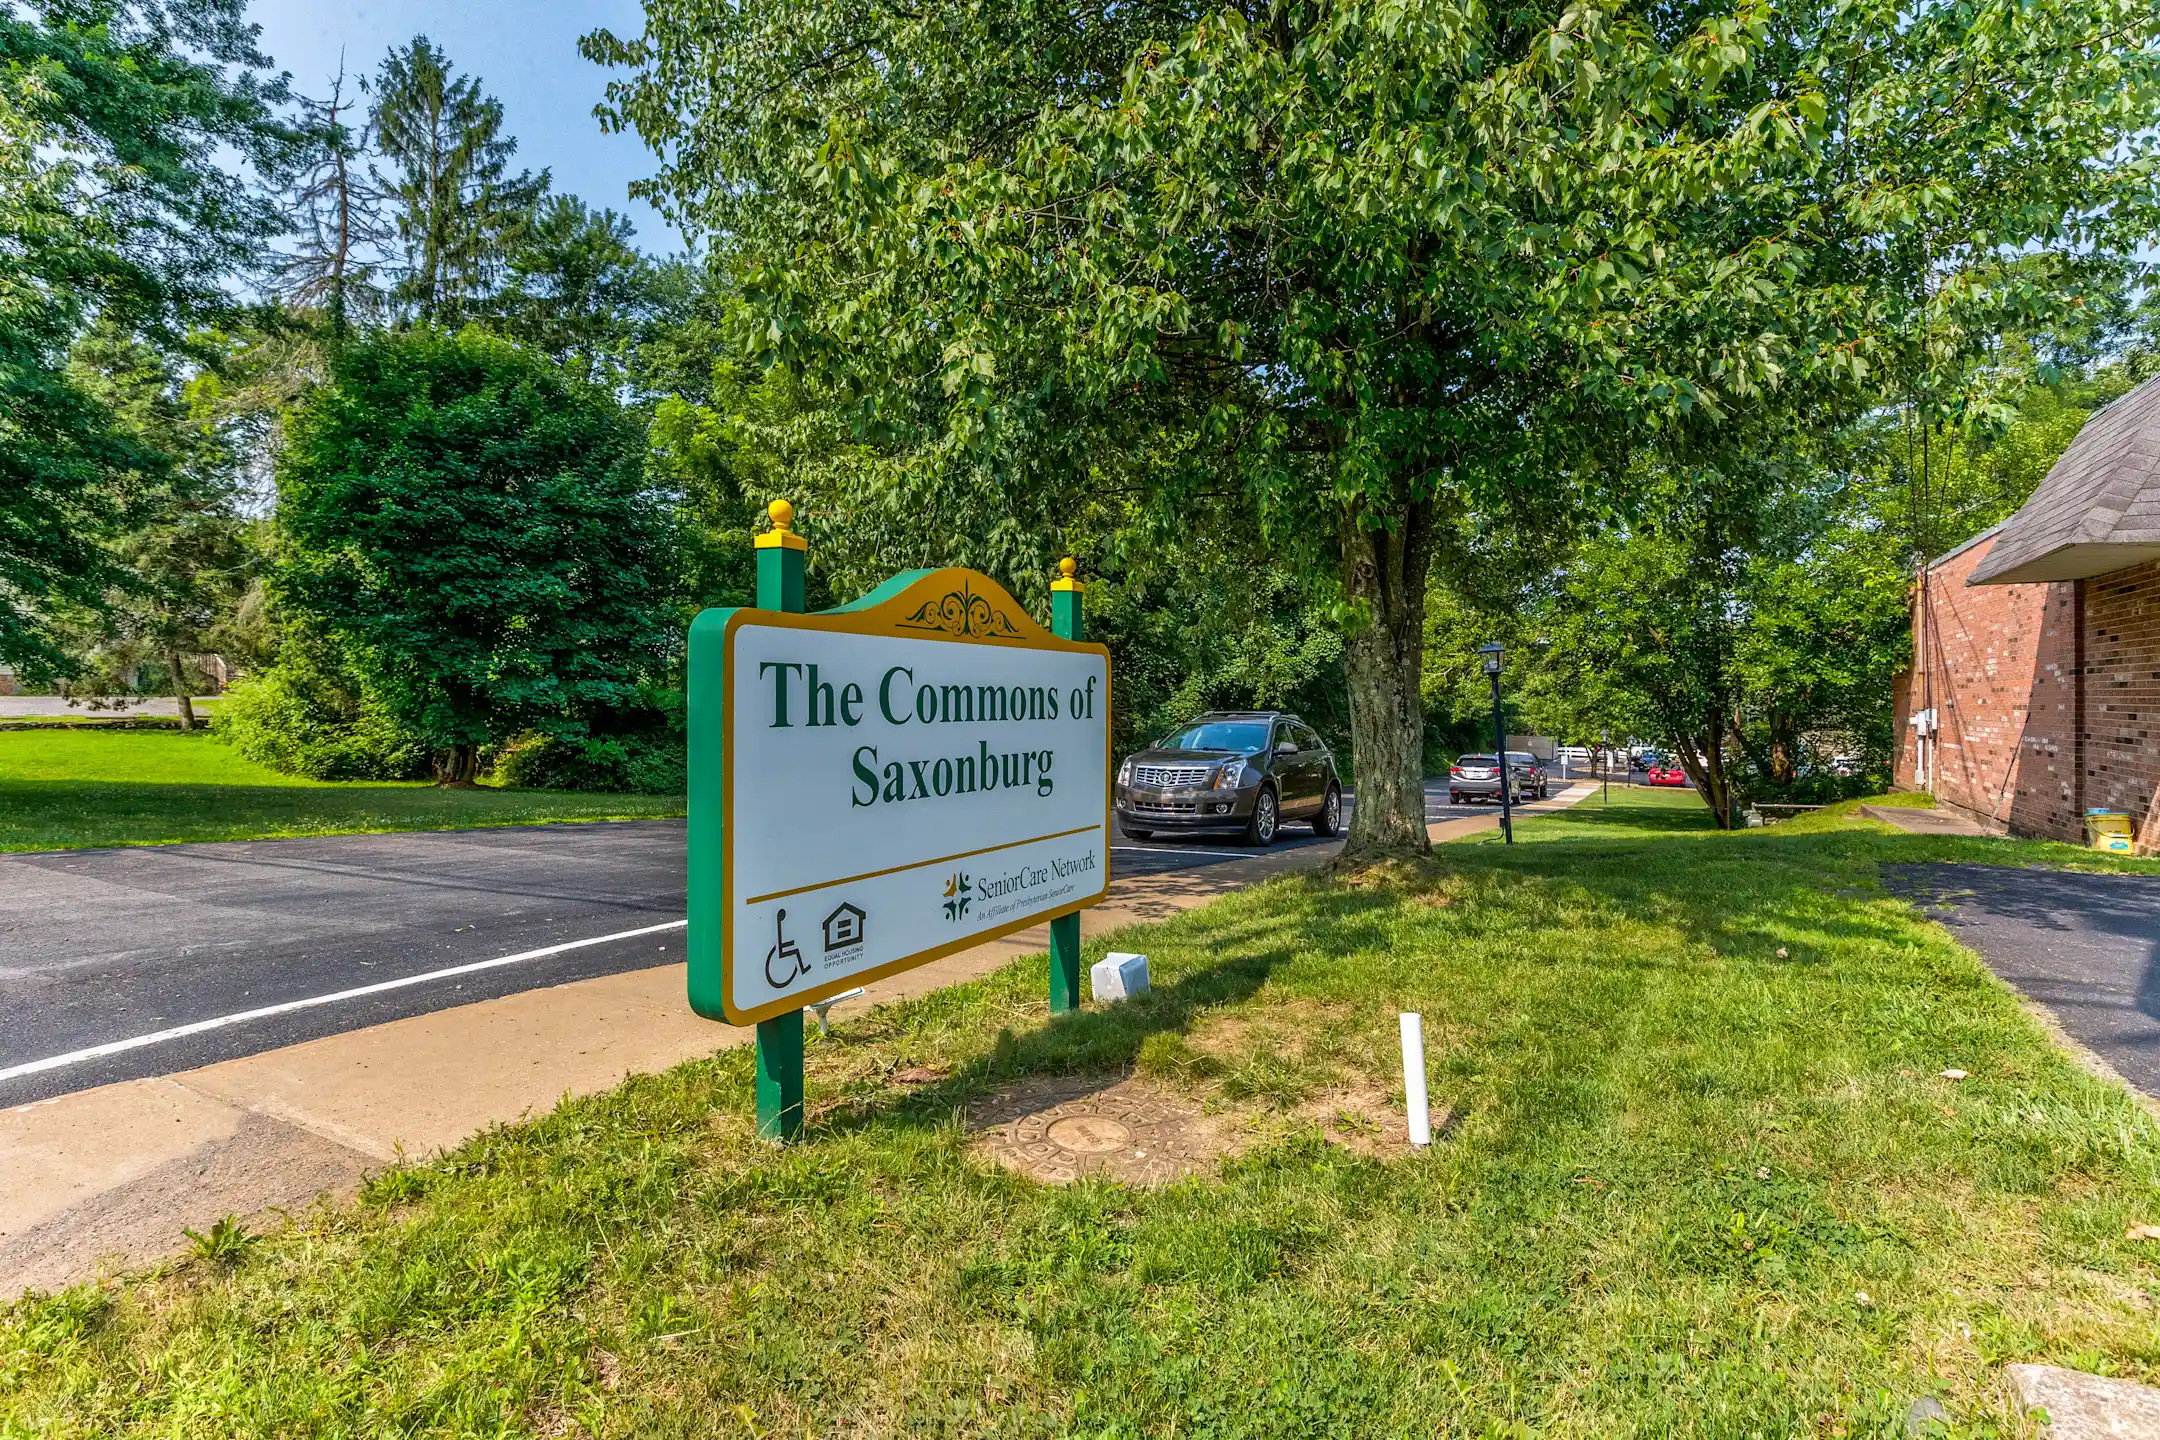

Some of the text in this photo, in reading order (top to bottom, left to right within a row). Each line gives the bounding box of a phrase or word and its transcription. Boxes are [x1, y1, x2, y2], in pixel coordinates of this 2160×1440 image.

[760, 662, 1097, 728] The Commons of
[852, 741, 1054, 808] Saxonburg
[977, 850, 1096, 902] SeniorCare Network
[977, 911, 986, 921] An
[986, 904, 1009, 920] Affiliate
[1016, 893, 1048, 909] Presbyterian
[1048, 884, 1075, 899] SeniorCare
[824, 946, 864, 962] EQUAL HOUSING
[824, 952, 864, 969] OPPORTUNITY
